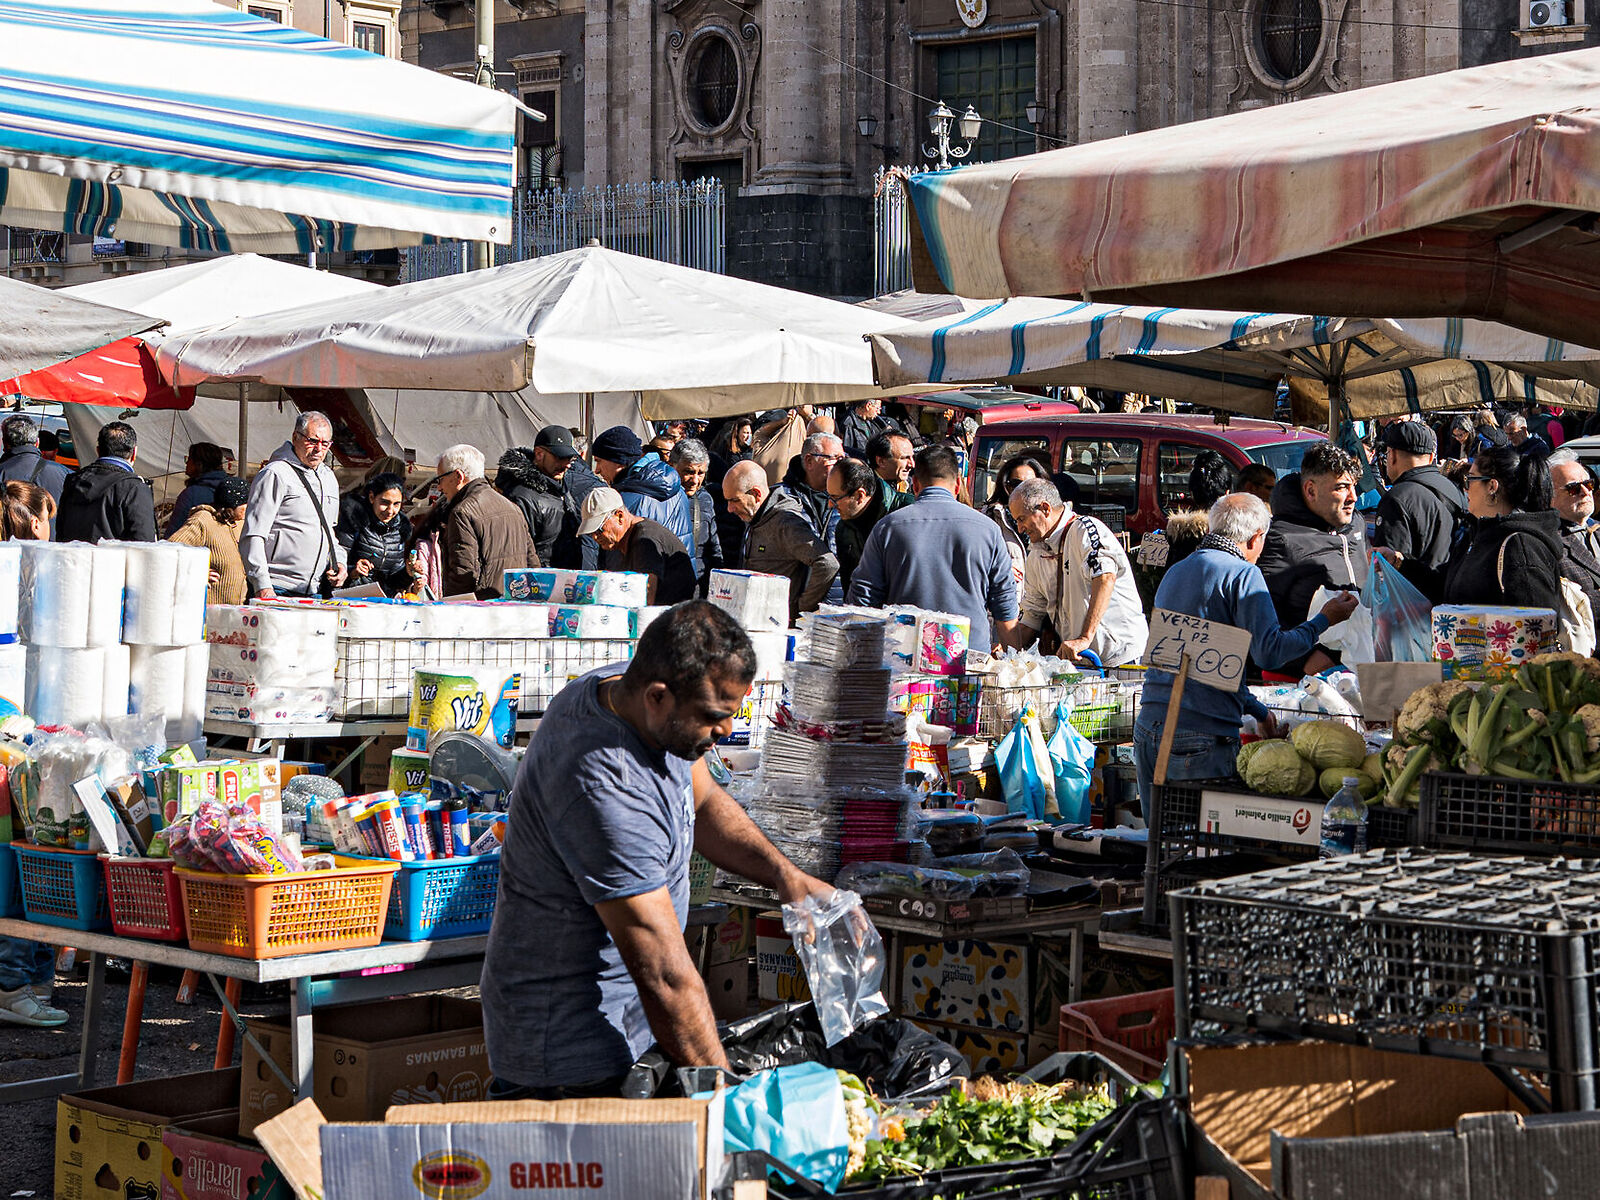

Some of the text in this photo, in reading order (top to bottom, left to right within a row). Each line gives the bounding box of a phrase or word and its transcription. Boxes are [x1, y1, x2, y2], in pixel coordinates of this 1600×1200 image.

[1160, 611, 1210, 631] VERZA
[1191, 631, 1209, 644] PZ
[419, 683, 438, 701] Vit
[450, 691, 484, 731] Vit
[405, 769, 427, 786] Vit
[1235, 808, 1266, 821] Palmieri
[1267, 813, 1292, 824] Emilio
[759, 952, 797, 968] BANANAS
[406, 1046, 466, 1066] BANANAS
[188, 1156, 242, 1200] Darelle
[508, 1161, 605, 1190] GARLIC
